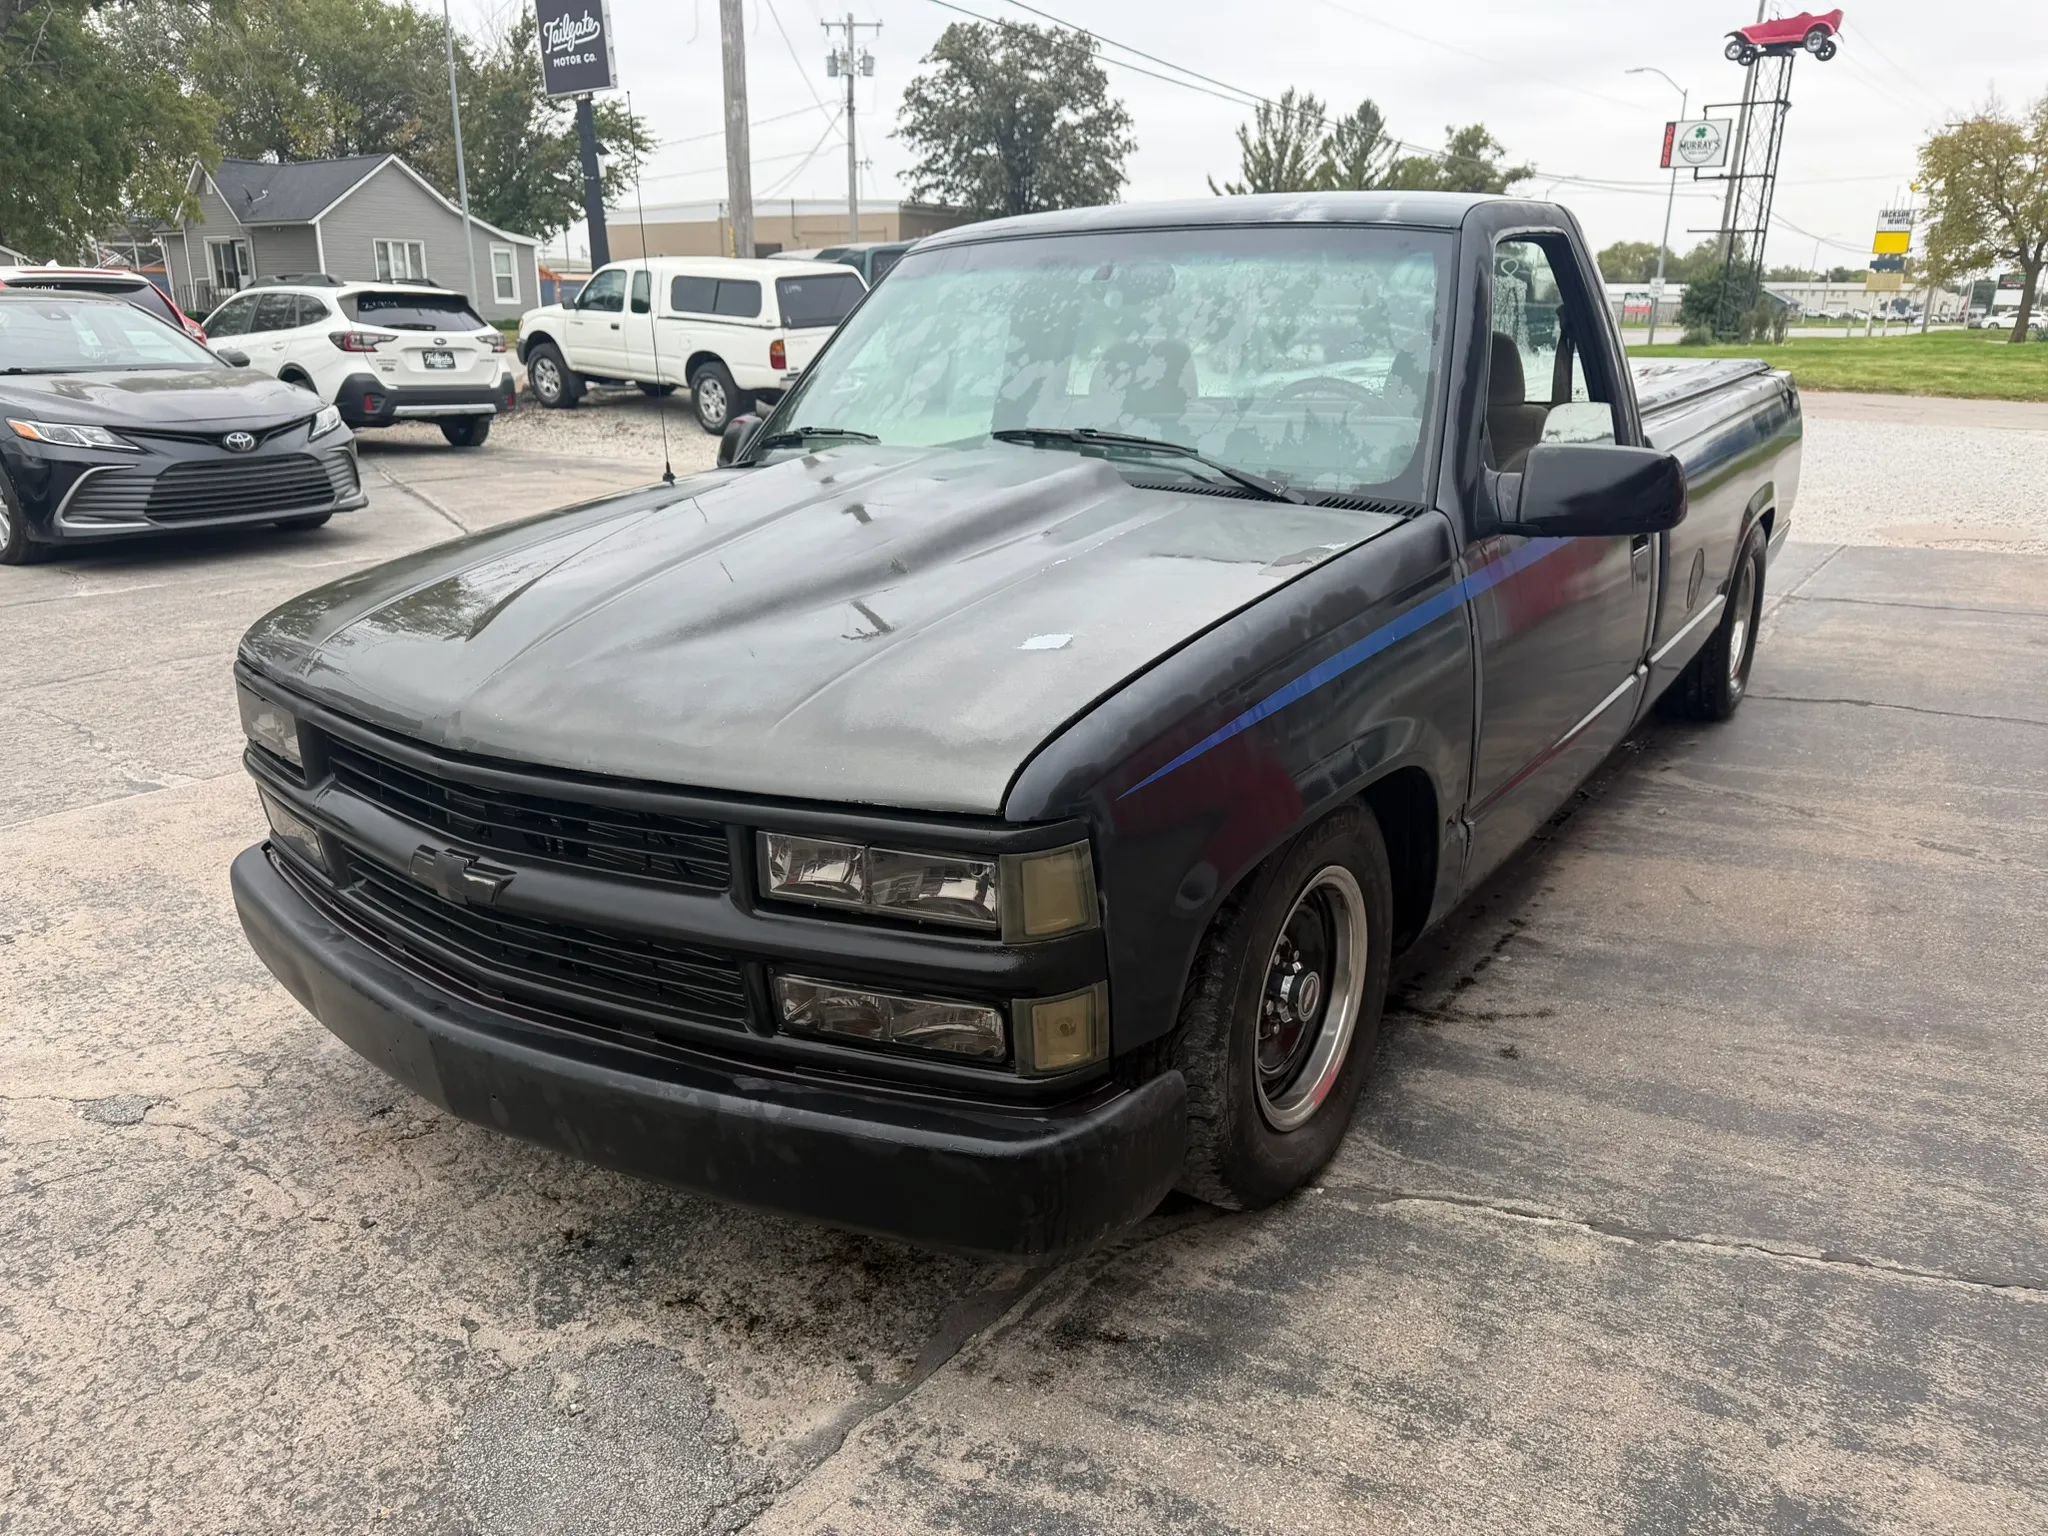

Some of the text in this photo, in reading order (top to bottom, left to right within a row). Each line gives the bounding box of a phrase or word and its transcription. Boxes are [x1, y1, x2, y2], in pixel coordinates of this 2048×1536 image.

[543, 9, 601, 54] Tailgate
[553, 53, 598, 67] MOTOR CO.
[1881, 209, 1910, 218] JACKSON
